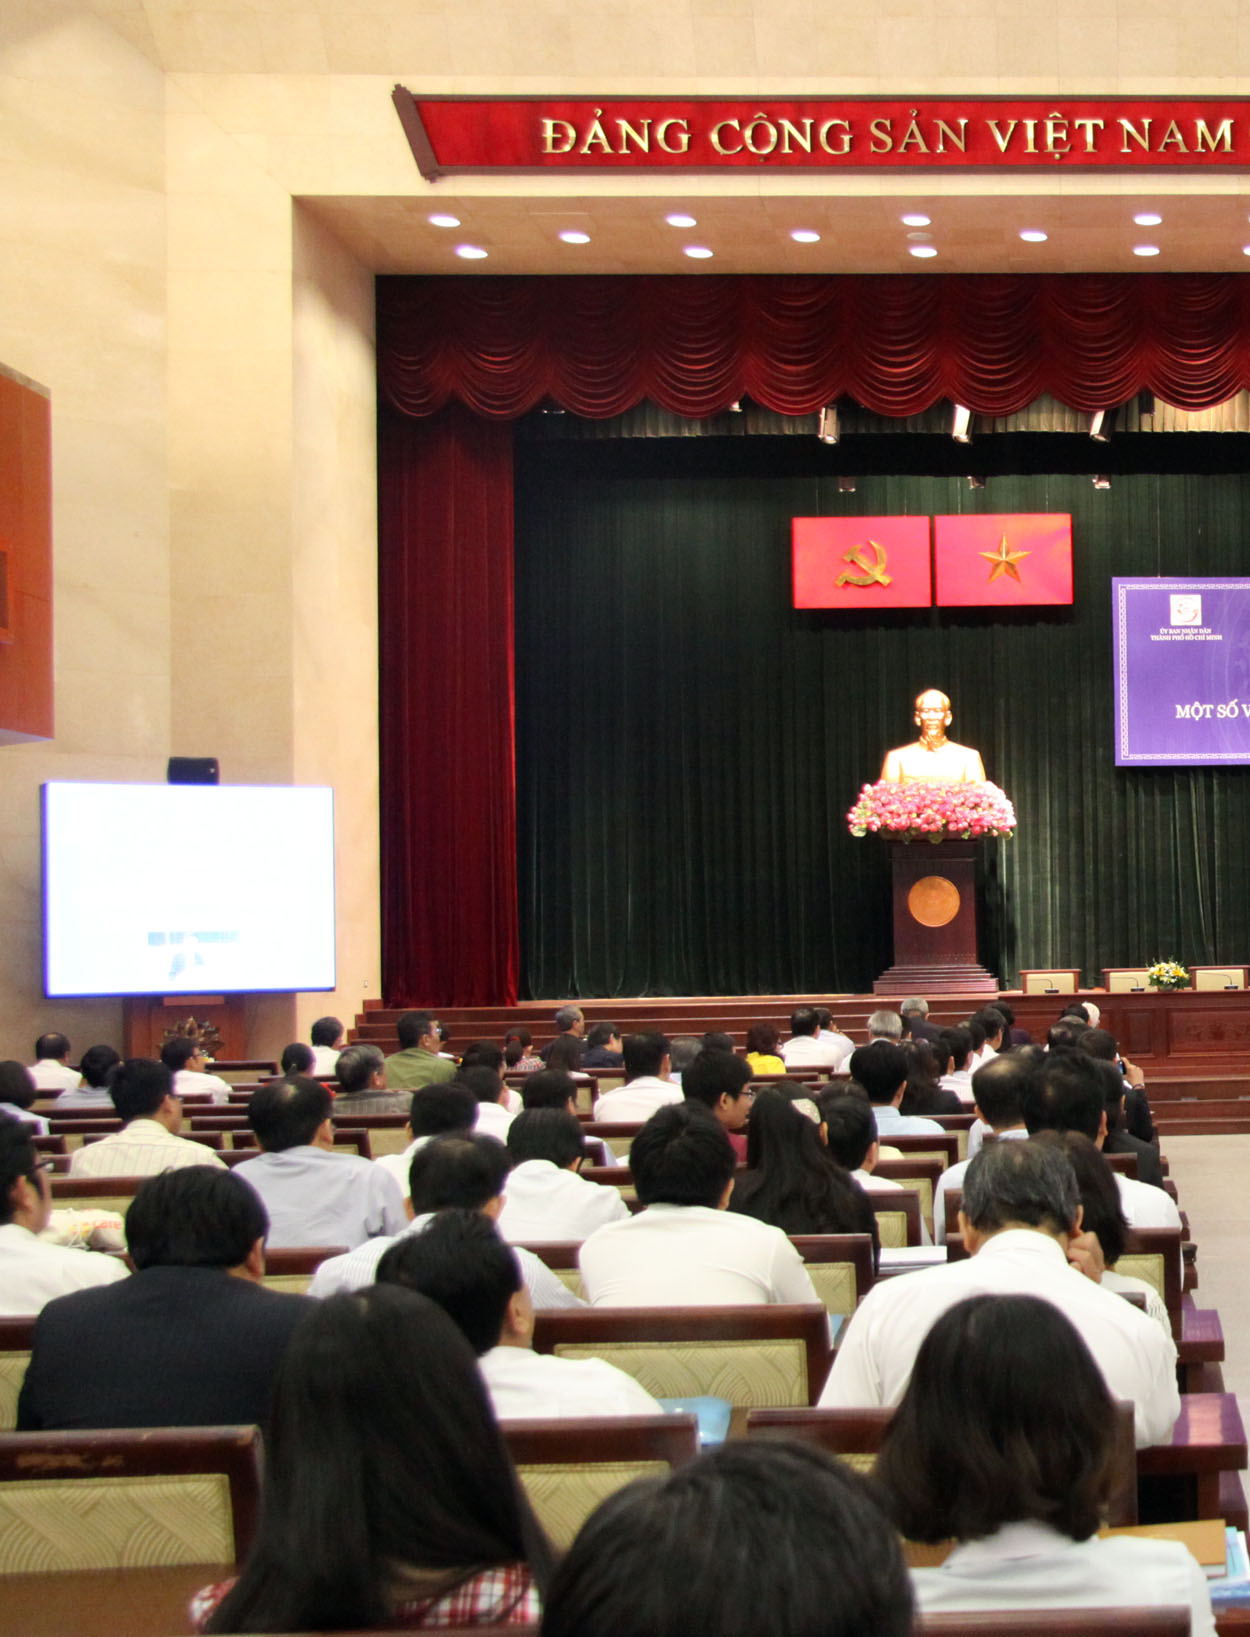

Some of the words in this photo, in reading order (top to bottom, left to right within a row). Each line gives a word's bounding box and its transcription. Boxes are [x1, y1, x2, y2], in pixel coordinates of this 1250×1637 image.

[542, 108, 692, 154] ĐẢNG
[711, 112, 854, 162] CỘNG
[870, 108, 968, 154] SẢN
[985, 111, 1104, 161] VIỆT
[1118, 119, 1235, 152] NAM
[1175, 701, 1213, 721] MỘT
[1217, 699, 1239, 718] SỐ
